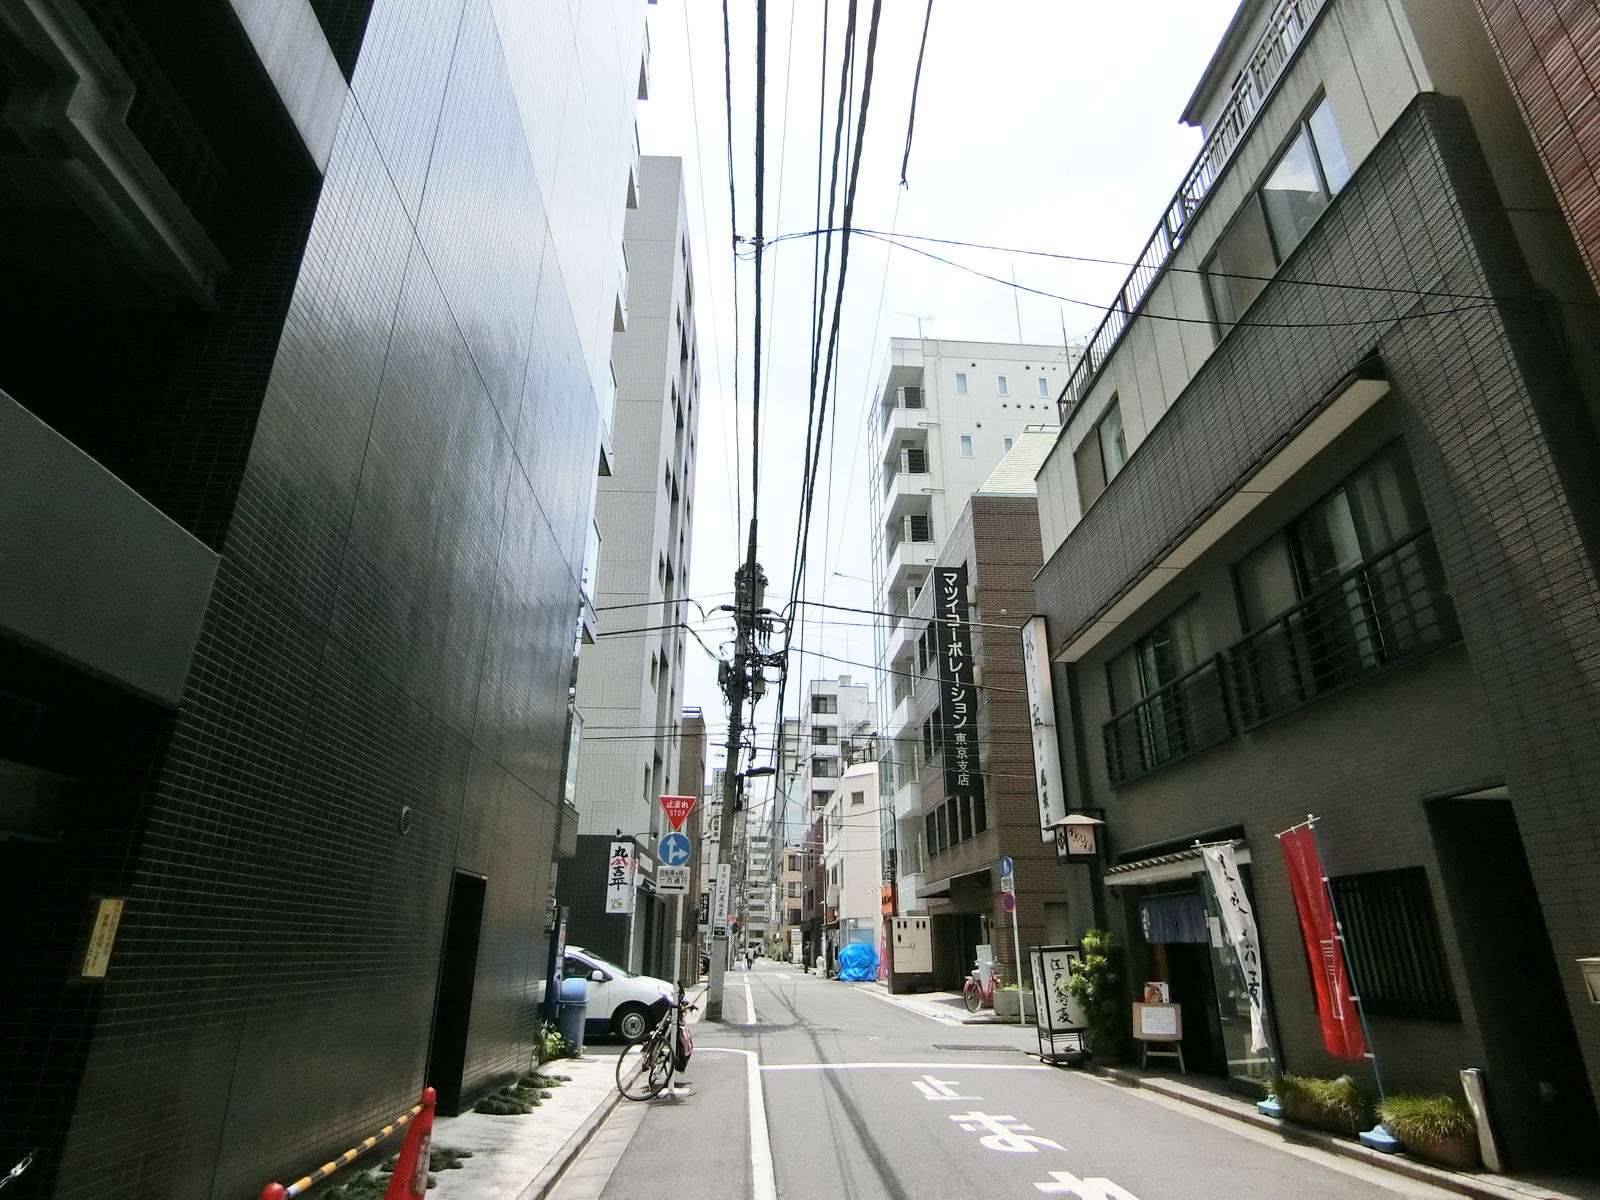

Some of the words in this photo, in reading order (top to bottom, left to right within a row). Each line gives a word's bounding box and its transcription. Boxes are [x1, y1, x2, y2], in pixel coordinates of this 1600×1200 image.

[943, 573, 967, 729] マツイコーポレーション
[954, 732, 970, 787] 東京支店
[666, 800, 689, 808] 止まれ
[669, 809, 686, 817] STOP
[658, 877, 688, 885] 一方通行
